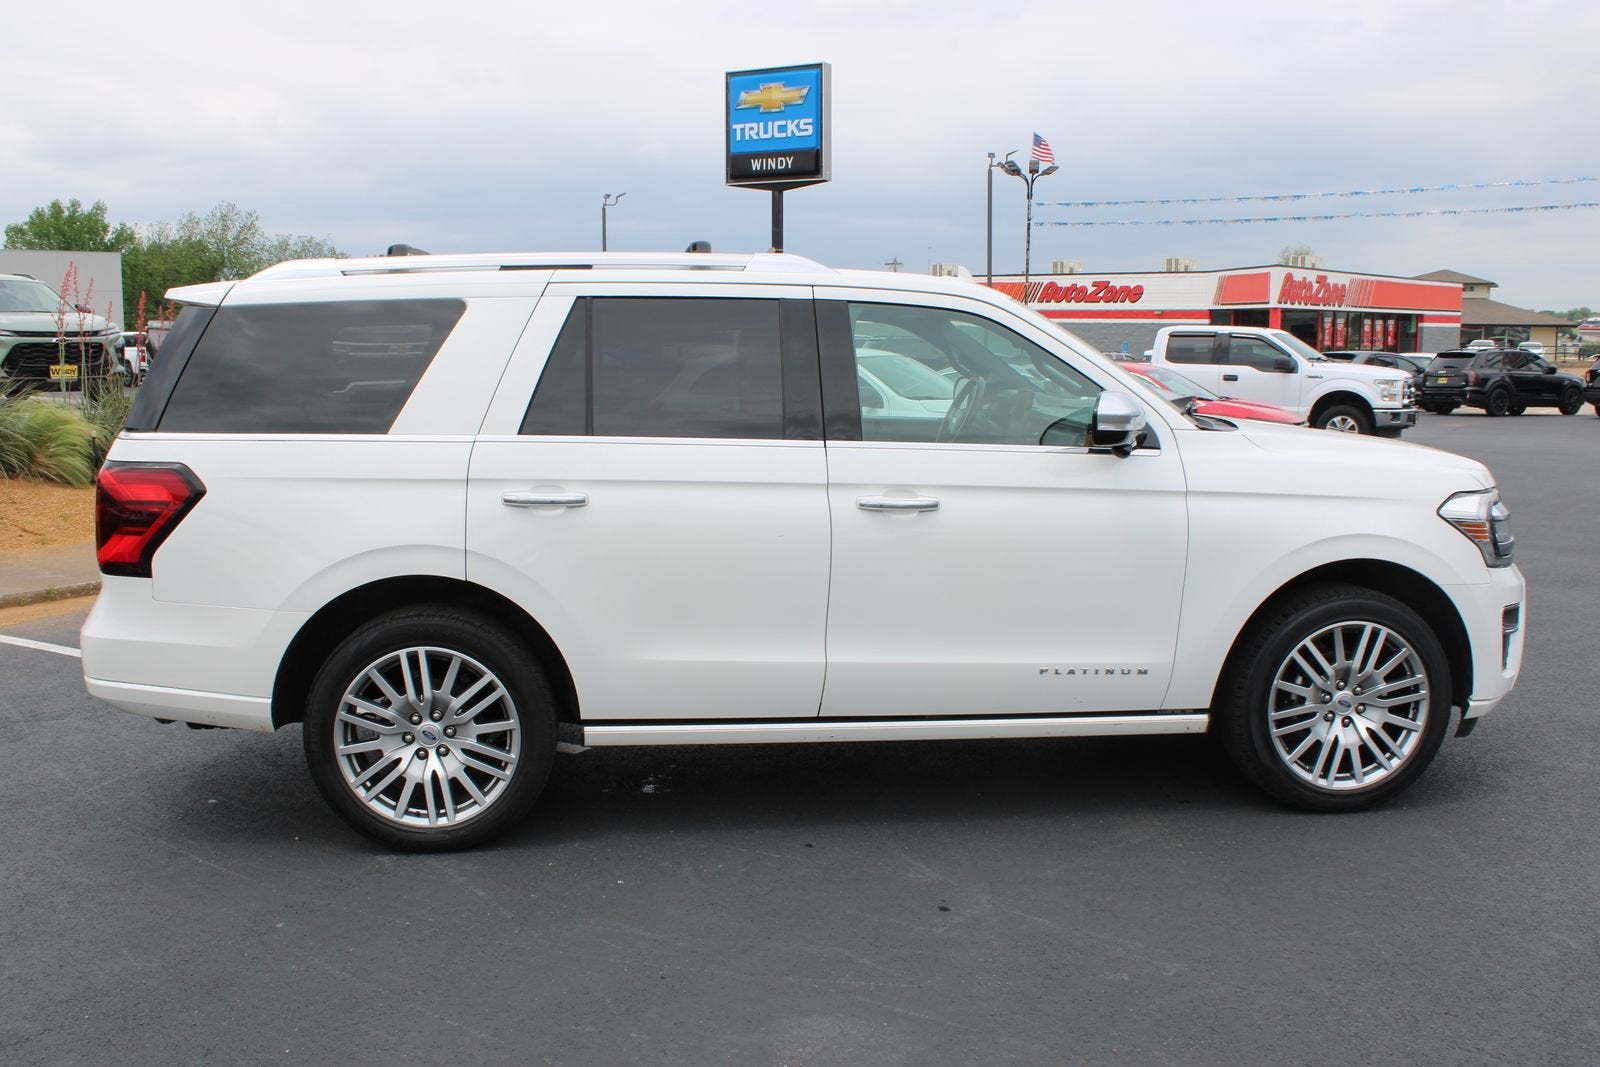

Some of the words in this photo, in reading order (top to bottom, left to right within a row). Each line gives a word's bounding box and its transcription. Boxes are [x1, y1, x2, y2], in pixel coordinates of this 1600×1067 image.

[732, 118, 813, 141] TRUCKS
[751, 156, 794, 171] WINDY
[1037, 281, 1144, 303] AutoZone
[1277, 272, 1346, 307] AutoZone
[1039, 666, 1149, 675] PLATINUM
